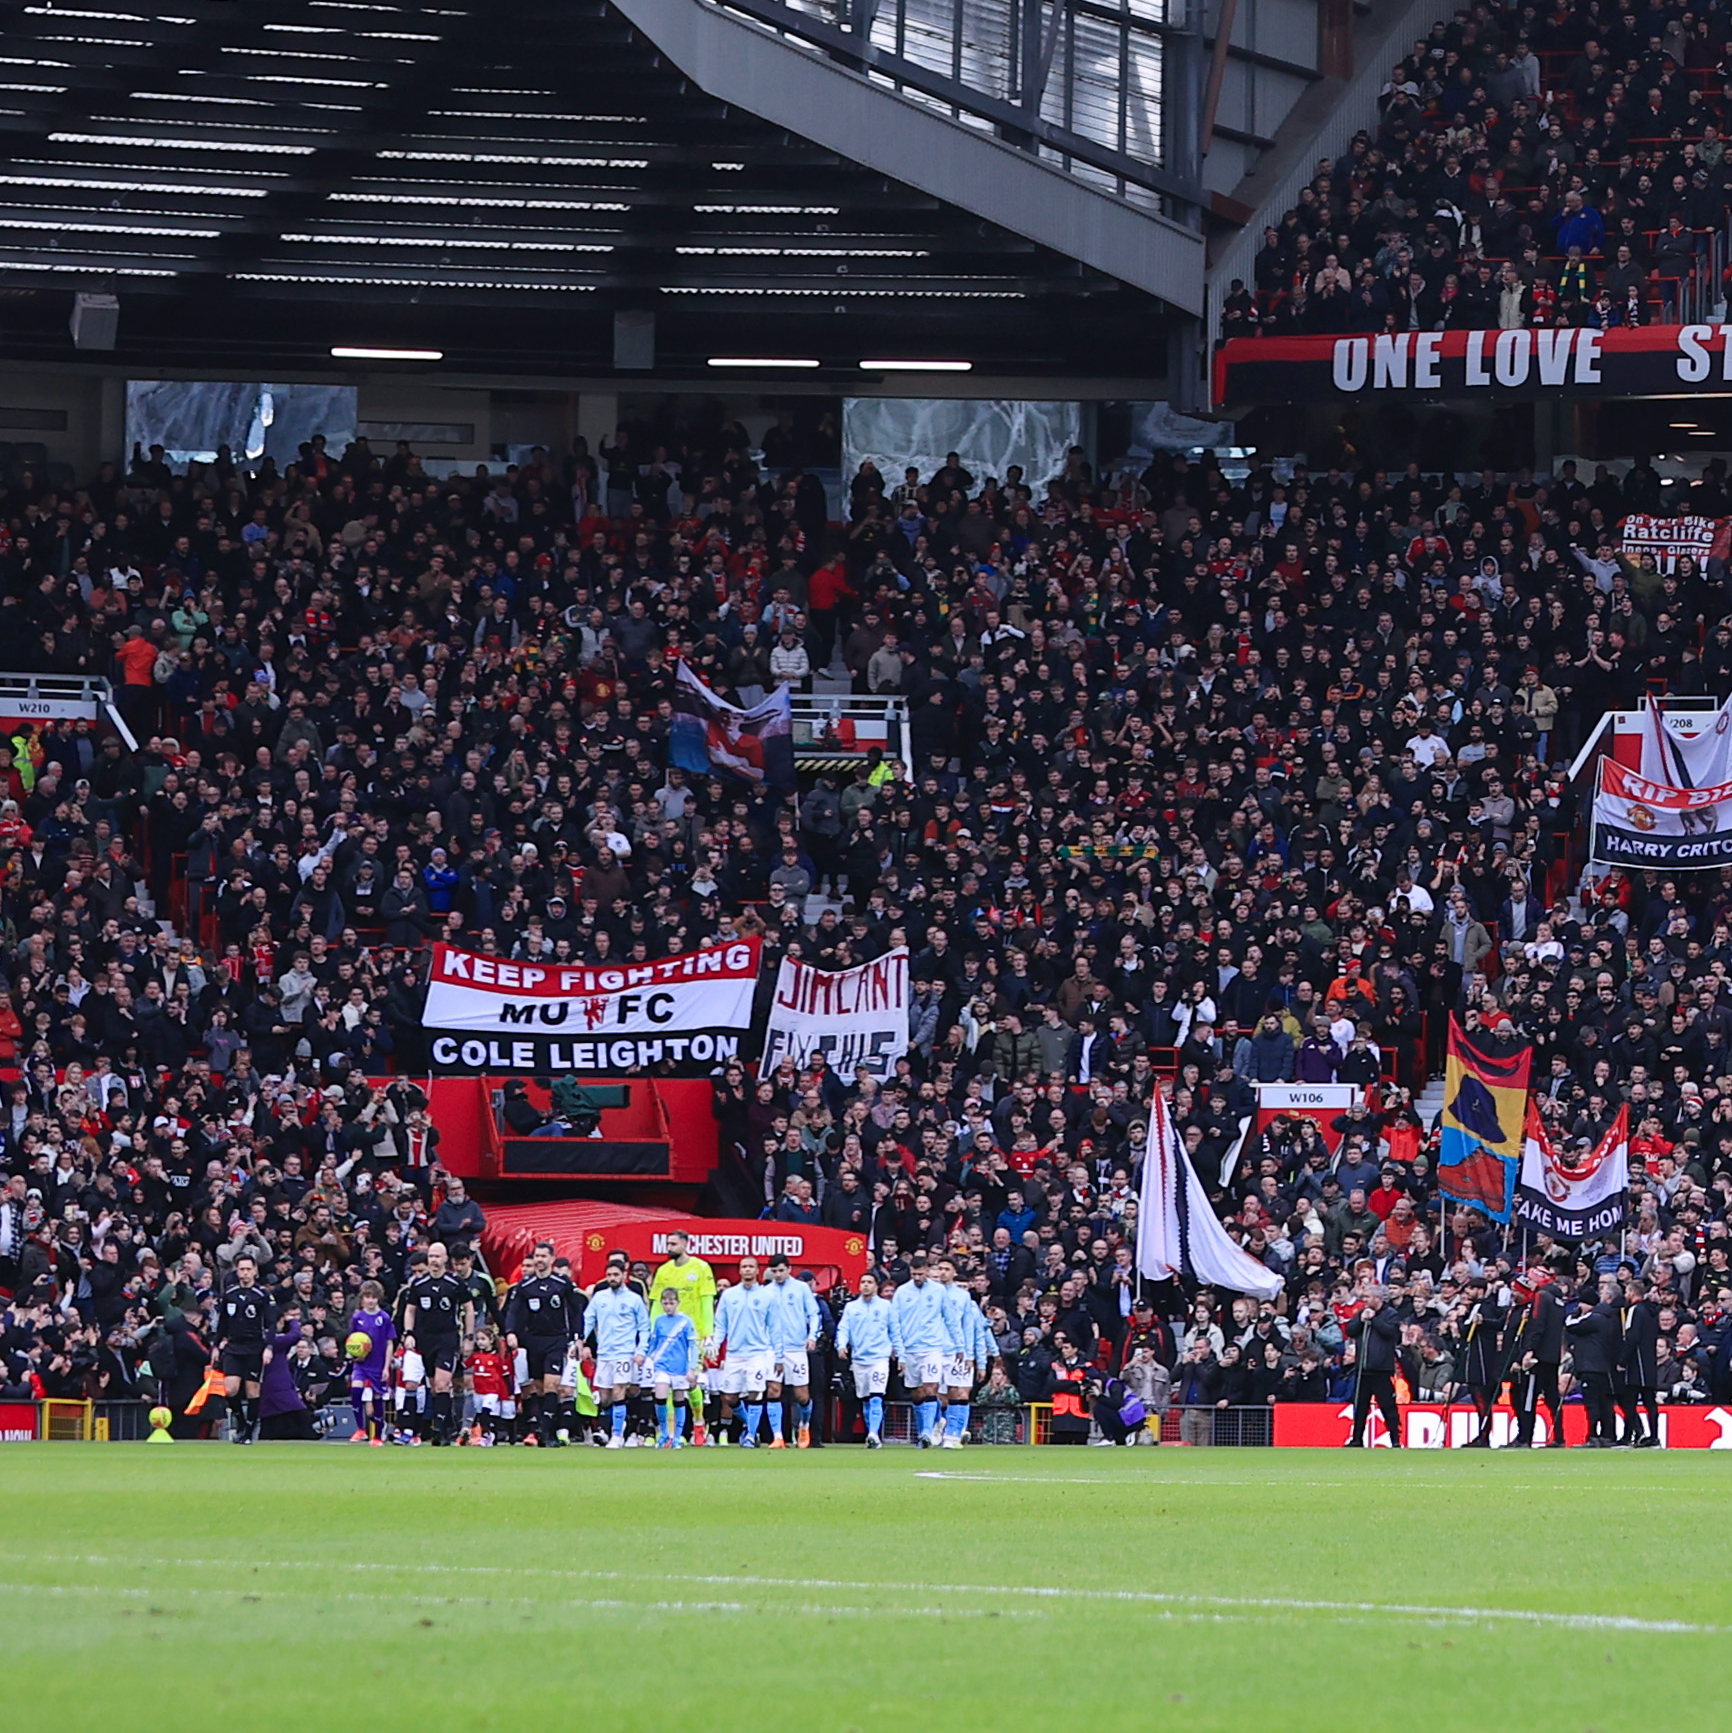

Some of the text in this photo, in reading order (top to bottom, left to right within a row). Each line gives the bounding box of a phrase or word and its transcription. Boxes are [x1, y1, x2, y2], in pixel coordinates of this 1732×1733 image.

[1333, 332, 1441, 392] ONE
[1465, 328, 1602, 387] LOVE
[1627, 514, 1644, 524] On
[1623, 524, 1714, 542] Ratcliffe
[19, 702, 50, 714] W210
[1621, 773, 1677, 803] RIP
[1607, 834, 1674, 858] HARRY
[443, 943, 751, 991] KEEP FIGHTING
[778, 955, 834, 1016] JIM
[500, 992, 676, 1025] MU FC
[432, 1034, 739, 1068] COLE LEIGHTON
[1289, 1092, 1323, 1104] W106
[1556, 1216, 1583, 1235] ME
[652, 1233, 804, 1257] MCHESTER UNITED
